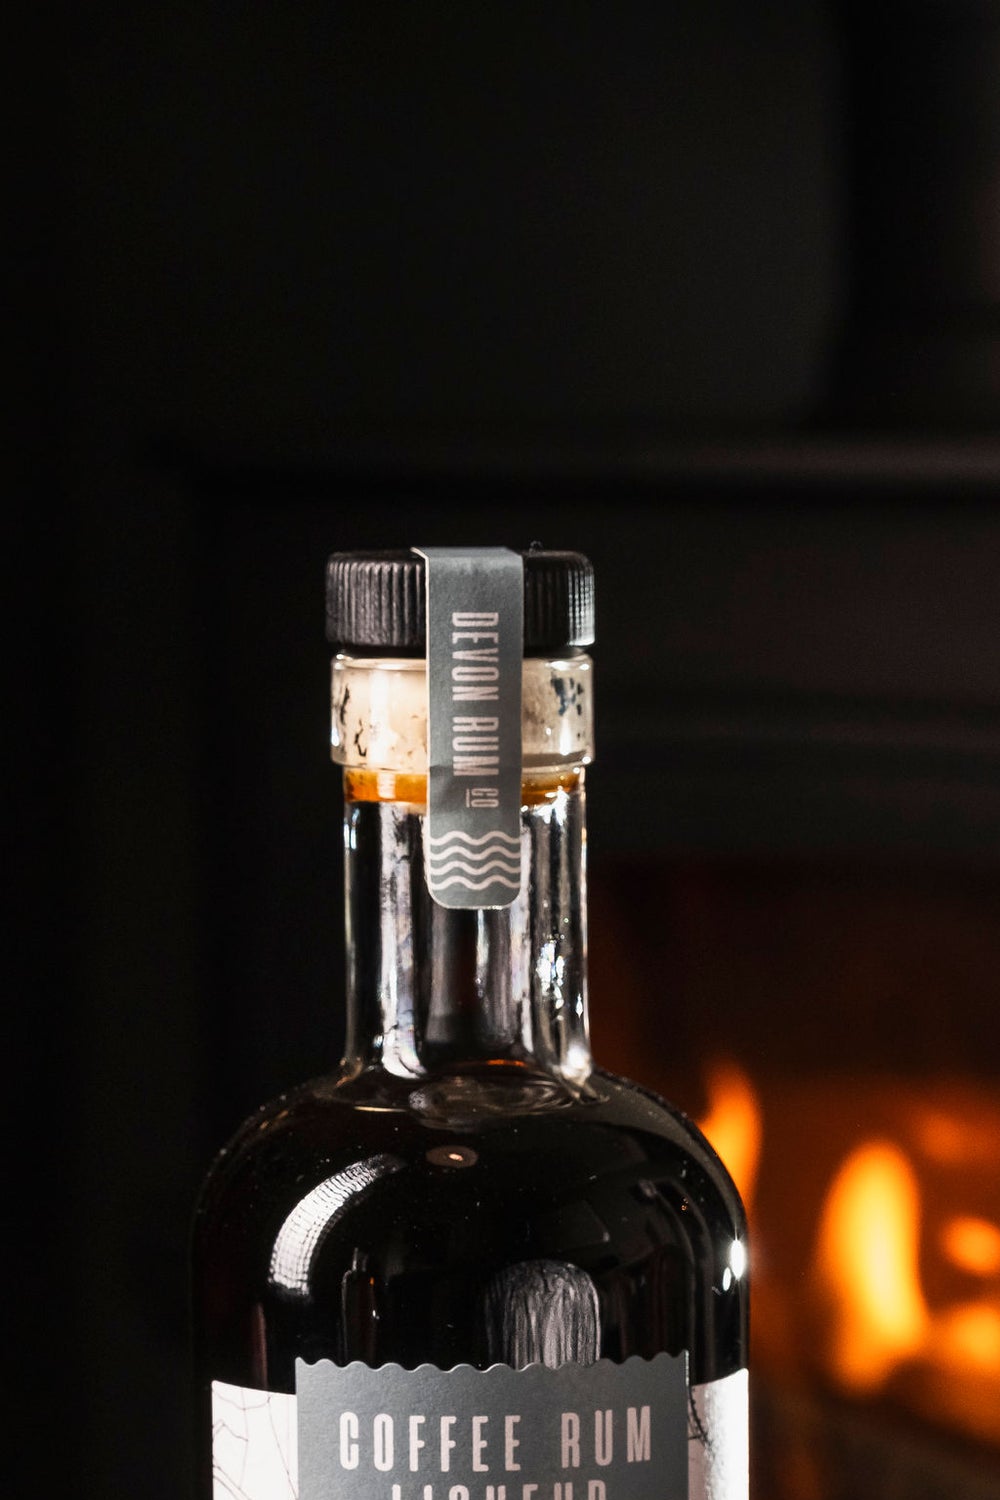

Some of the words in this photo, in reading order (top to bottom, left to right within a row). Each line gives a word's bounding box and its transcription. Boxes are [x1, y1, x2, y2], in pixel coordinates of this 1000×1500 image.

[452, 612, 499, 701] DEVON
[452, 717, 499, 777] RUM
[467, 787, 499, 808] CO
[339, 1411, 521, 1472] COFFEE
[561, 1406, 651, 1468] RUM
